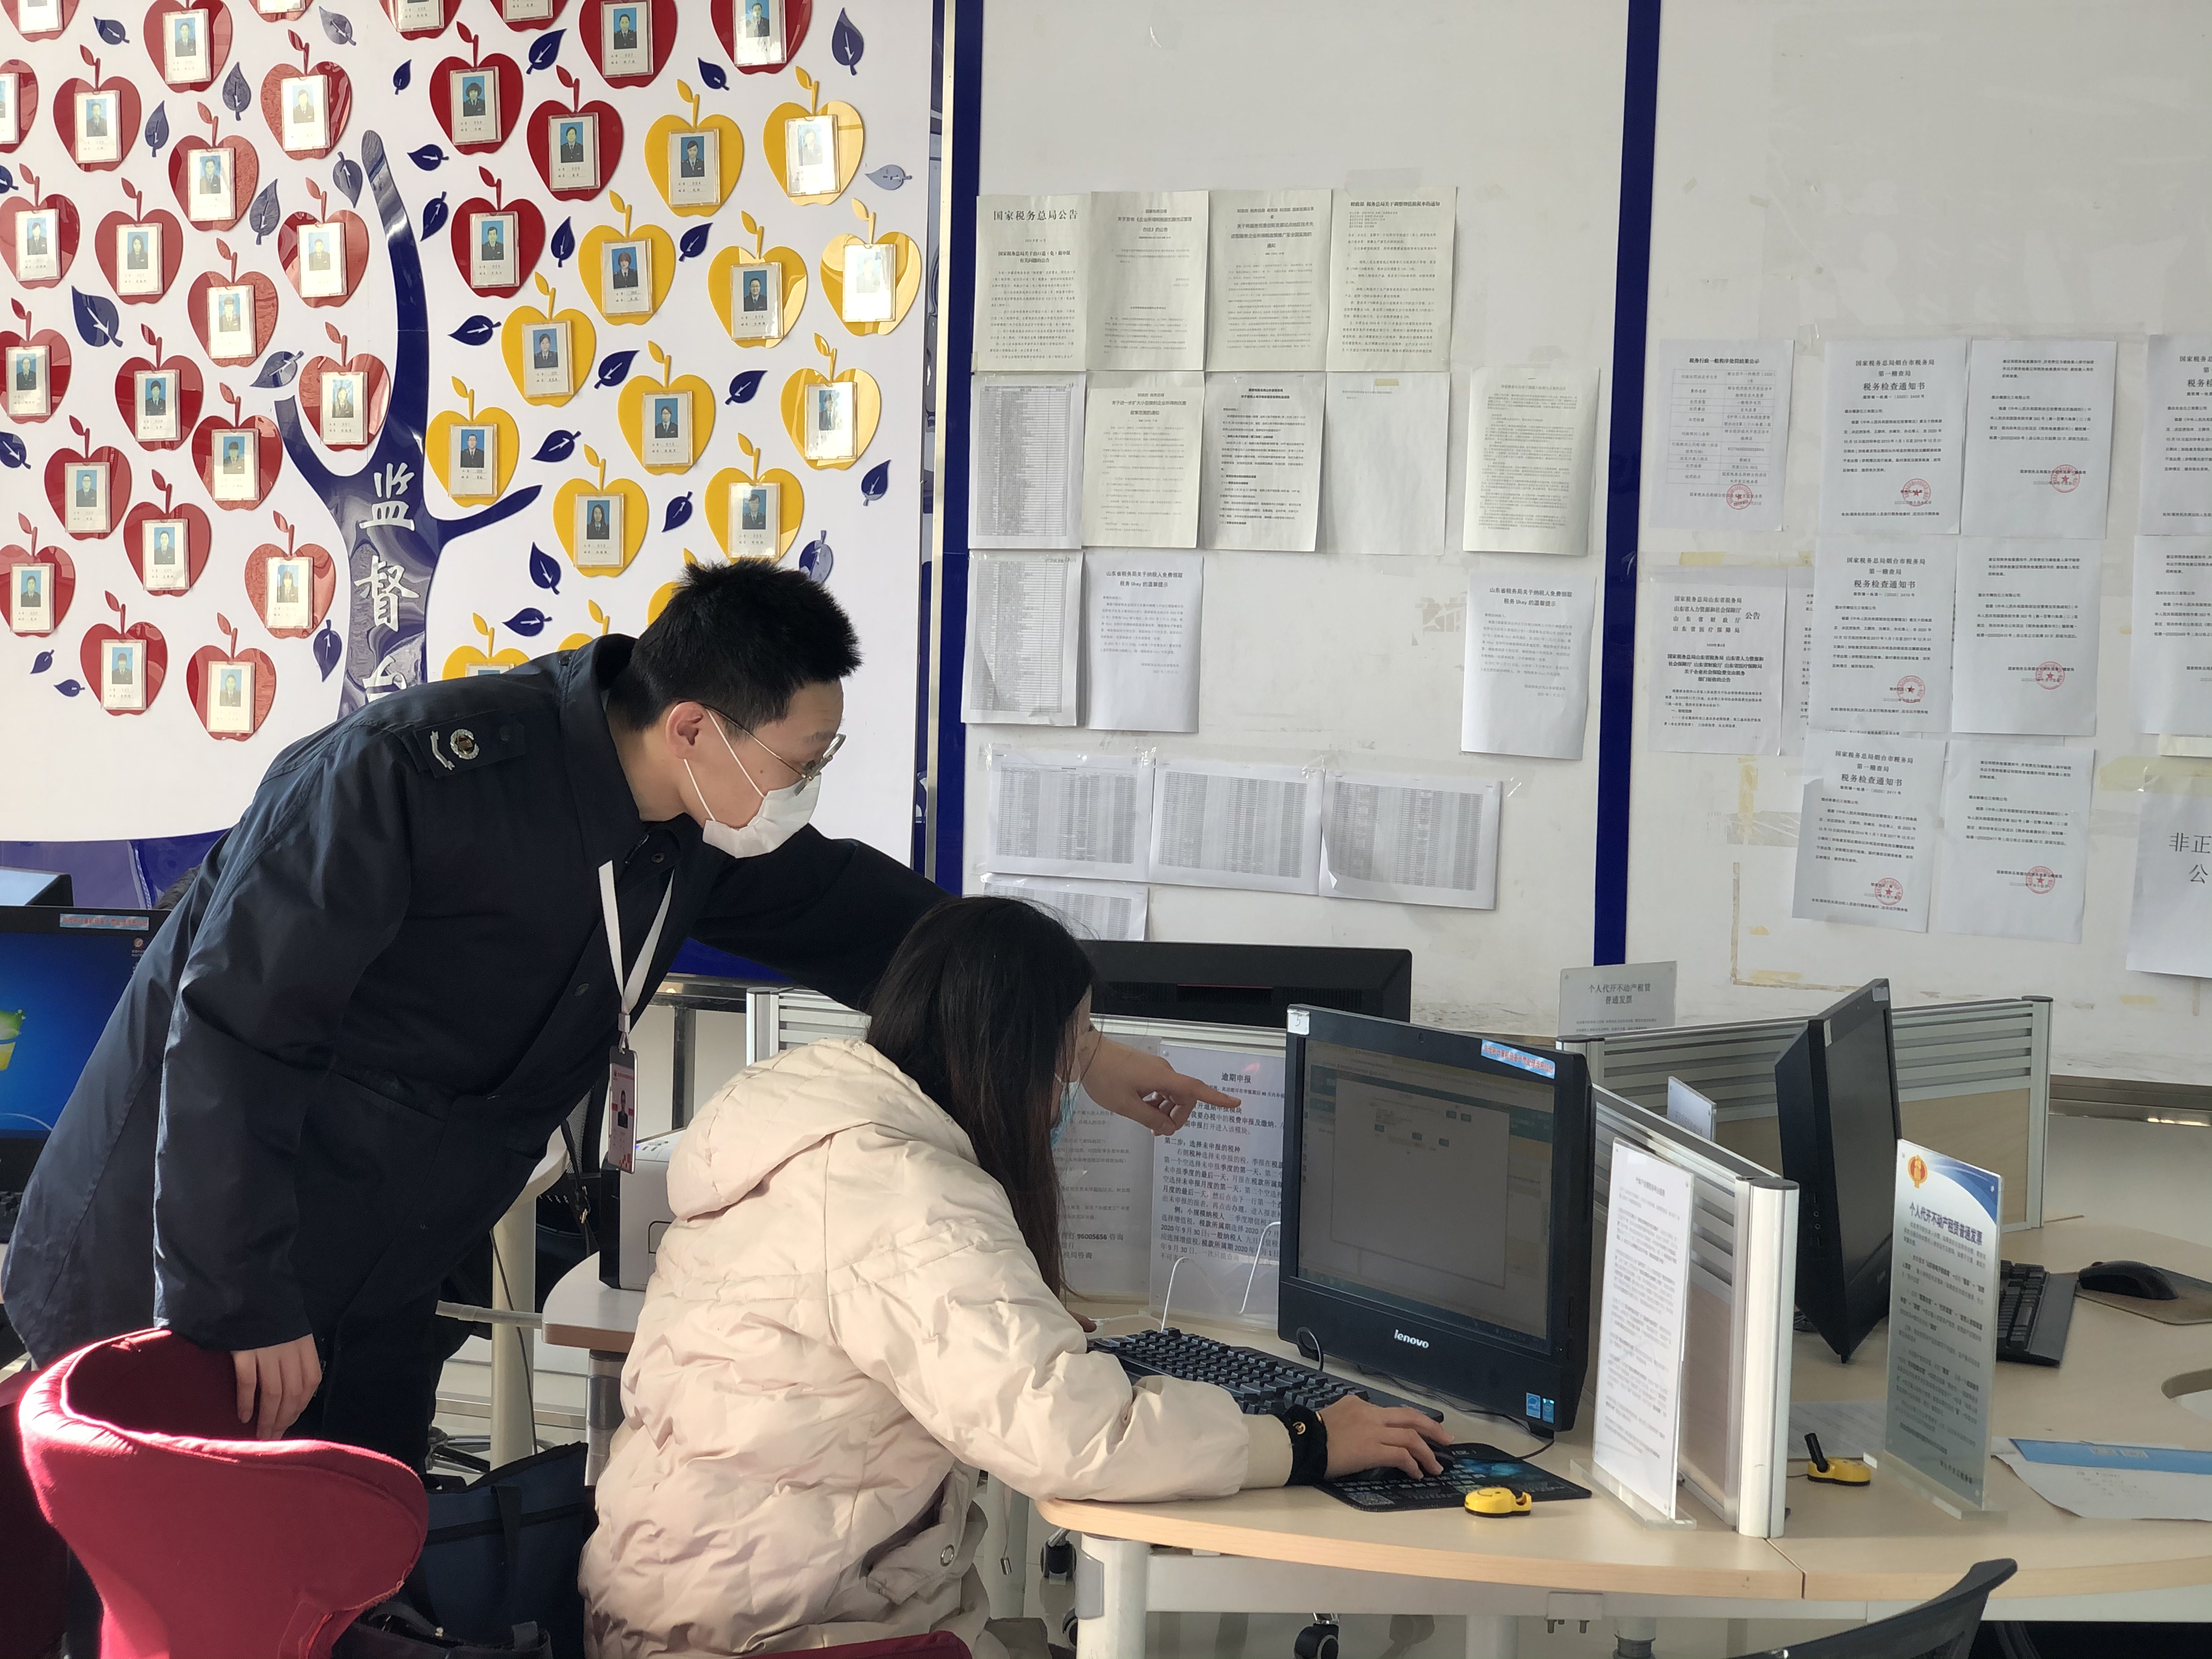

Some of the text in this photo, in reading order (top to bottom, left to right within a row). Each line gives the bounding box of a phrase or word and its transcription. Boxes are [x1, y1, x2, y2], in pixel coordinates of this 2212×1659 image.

[994, 209, 1078, 221] 国家税务总局公告
[1863, 382, 1926, 391] 税务检查通知书
[1854, 580, 1916, 589] 税务检查通知书
[1489, 587, 1573, 597] 山东省税务局关于纳税人免费领取
[1674, 595, 1742, 604] 国家税务总局山东省税务局
[1674, 606, 1742, 614] 山东省人力资源和社会保障厅
[1745, 612, 1761, 620] 公告
[1835, 750, 1914, 764] 国家税务总局烟台市税务局
[1857, 763, 1889, 772] 第一稽查局
[1841, 774, 1903, 787] 税务检查通知书
[2169, 832, 2212, 854] 非正
[2189, 864, 2208, 884] 公
[1589, 983, 1651, 994] 个人代开不动产租赁
[1605, 995, 1633, 1005] 普通发票
[1295, 1015, 1301, 1027] 5
[1221, 1072, 1251, 1084] 逾期申报
[1909, 1201, 1983, 1246] 个人代开不动产租赁普通发票
[1394, 1329, 1430, 1349] lenovo
